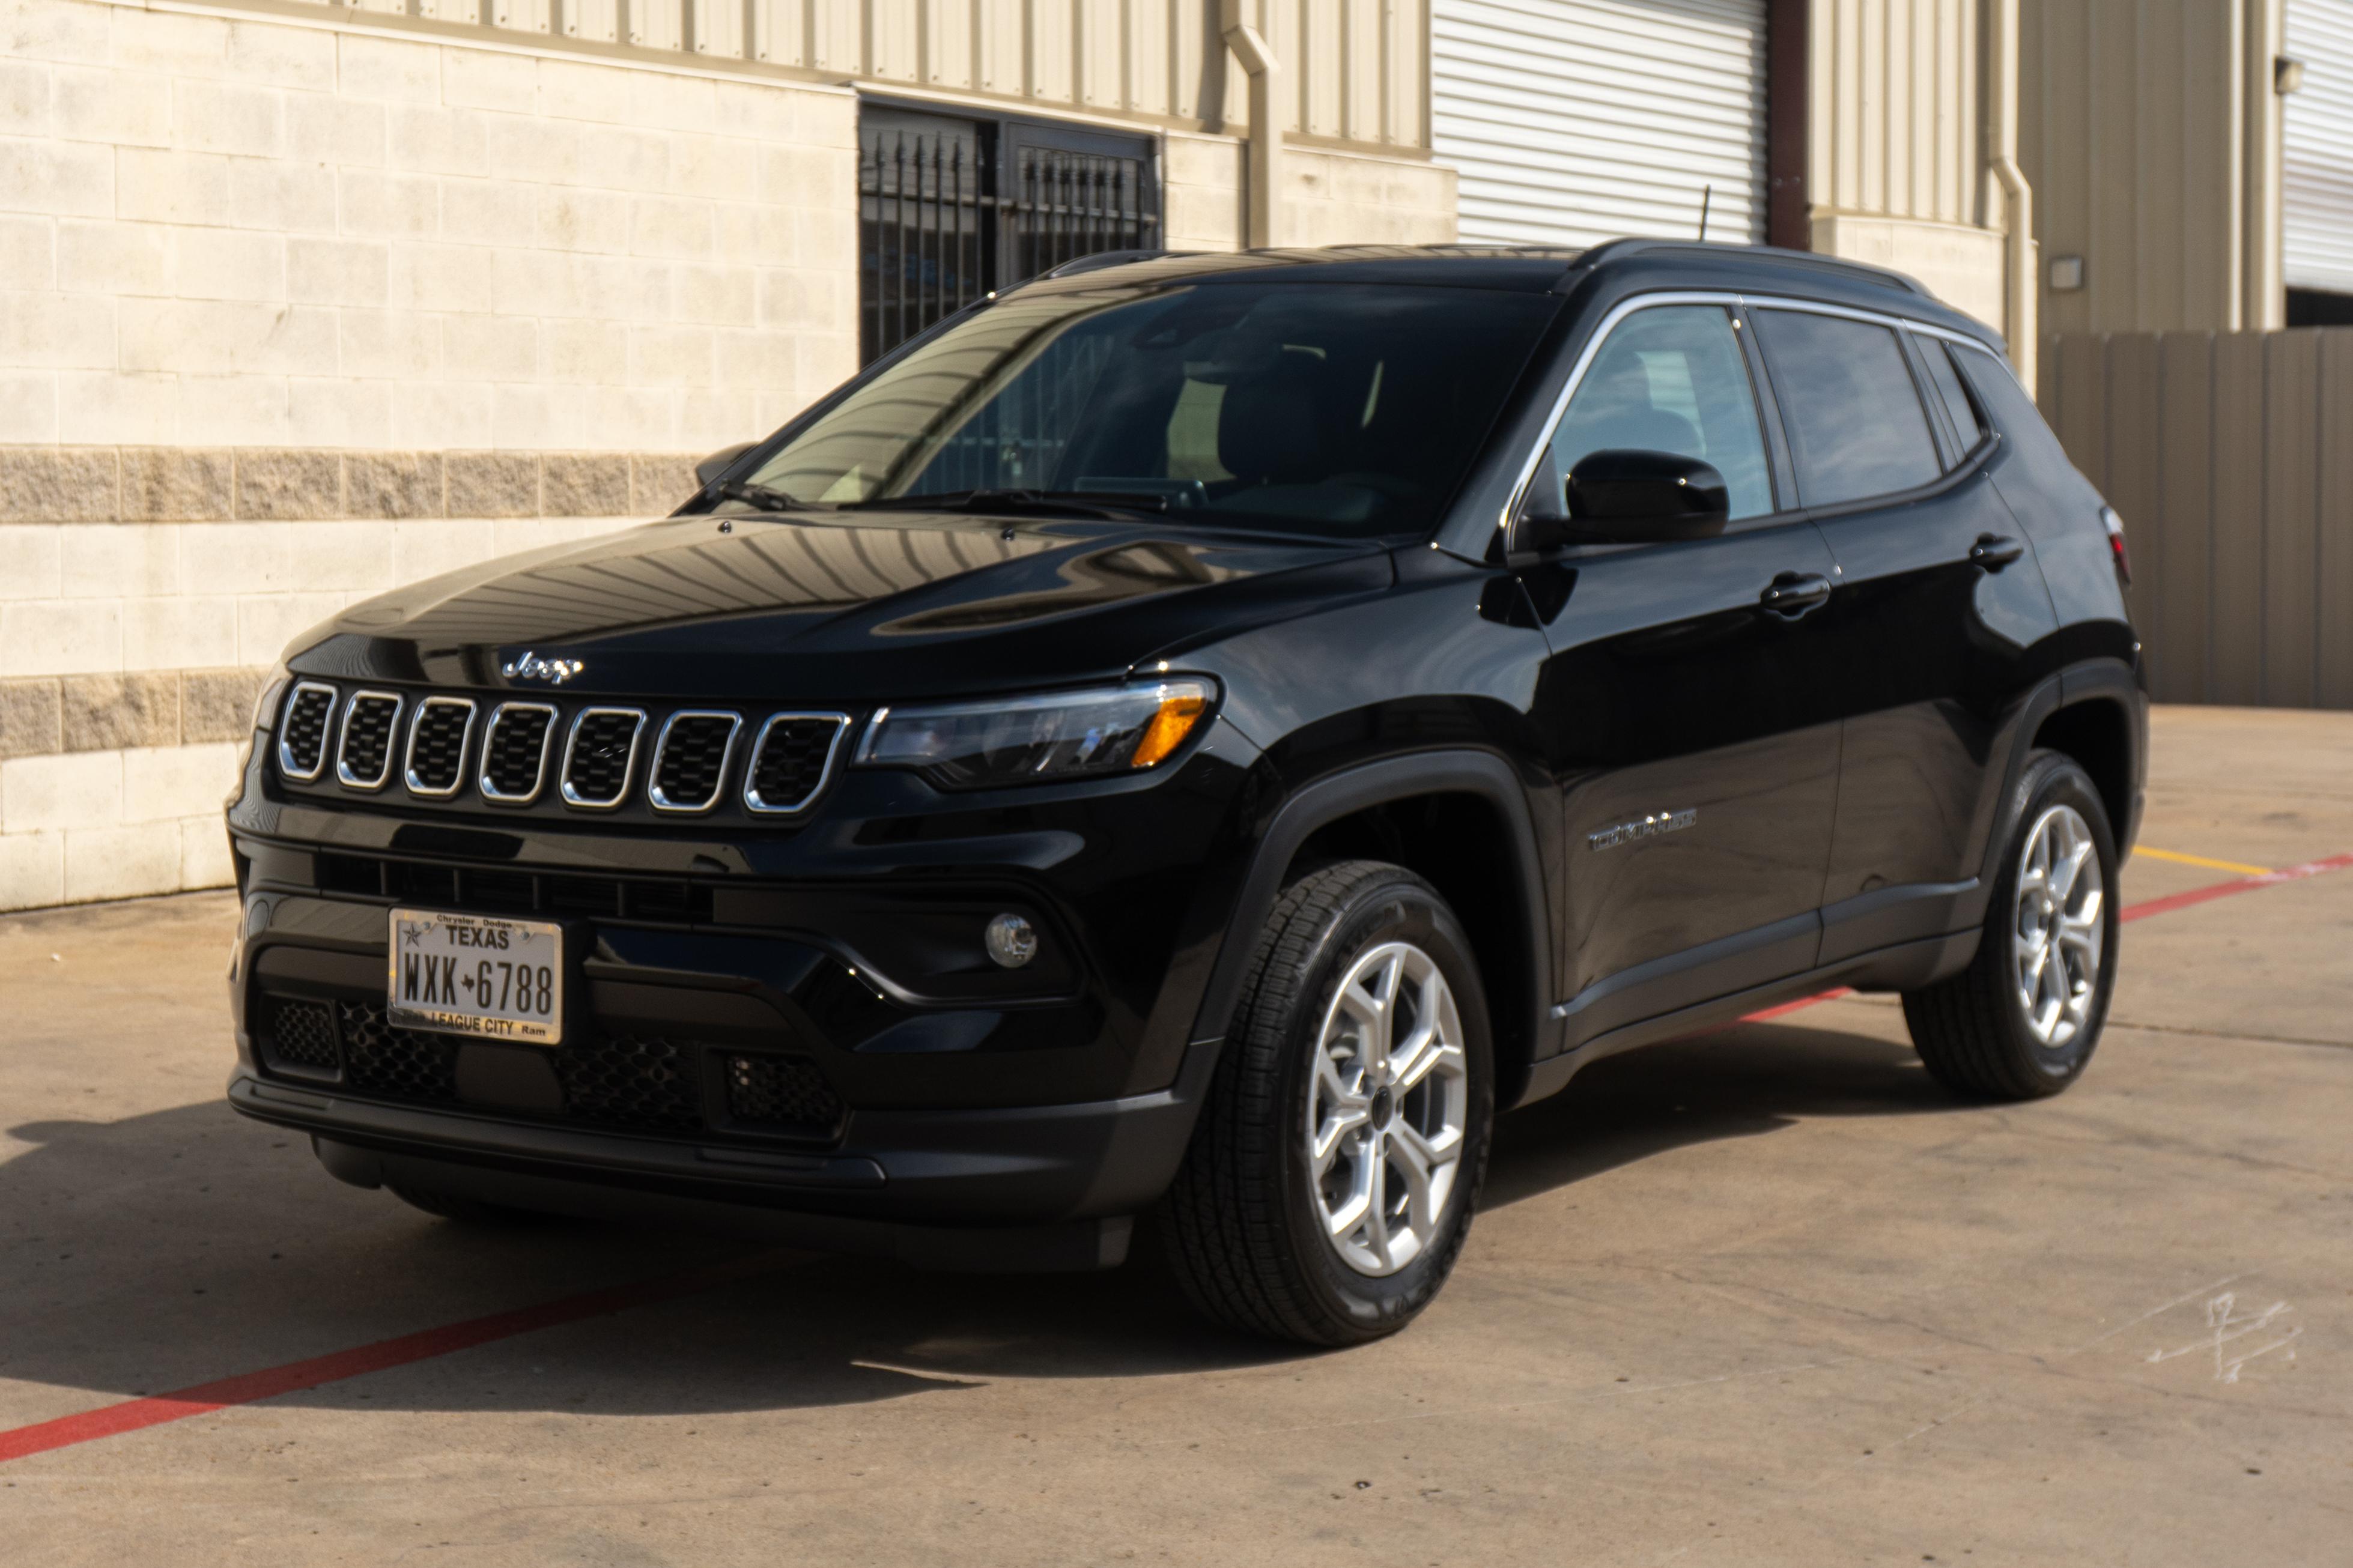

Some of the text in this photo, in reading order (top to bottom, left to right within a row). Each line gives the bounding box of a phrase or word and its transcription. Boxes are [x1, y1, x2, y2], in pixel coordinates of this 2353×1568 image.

[502, 651, 584, 685] Jeep
[437, 913, 512, 929] Chrysler Dodge
[445, 925, 510, 951] TEXAS
[431, 1012, 481, 1032] LEAGUE
[484, 1019, 514, 1035] CITY
[521, 1025, 546, 1037] Ram
